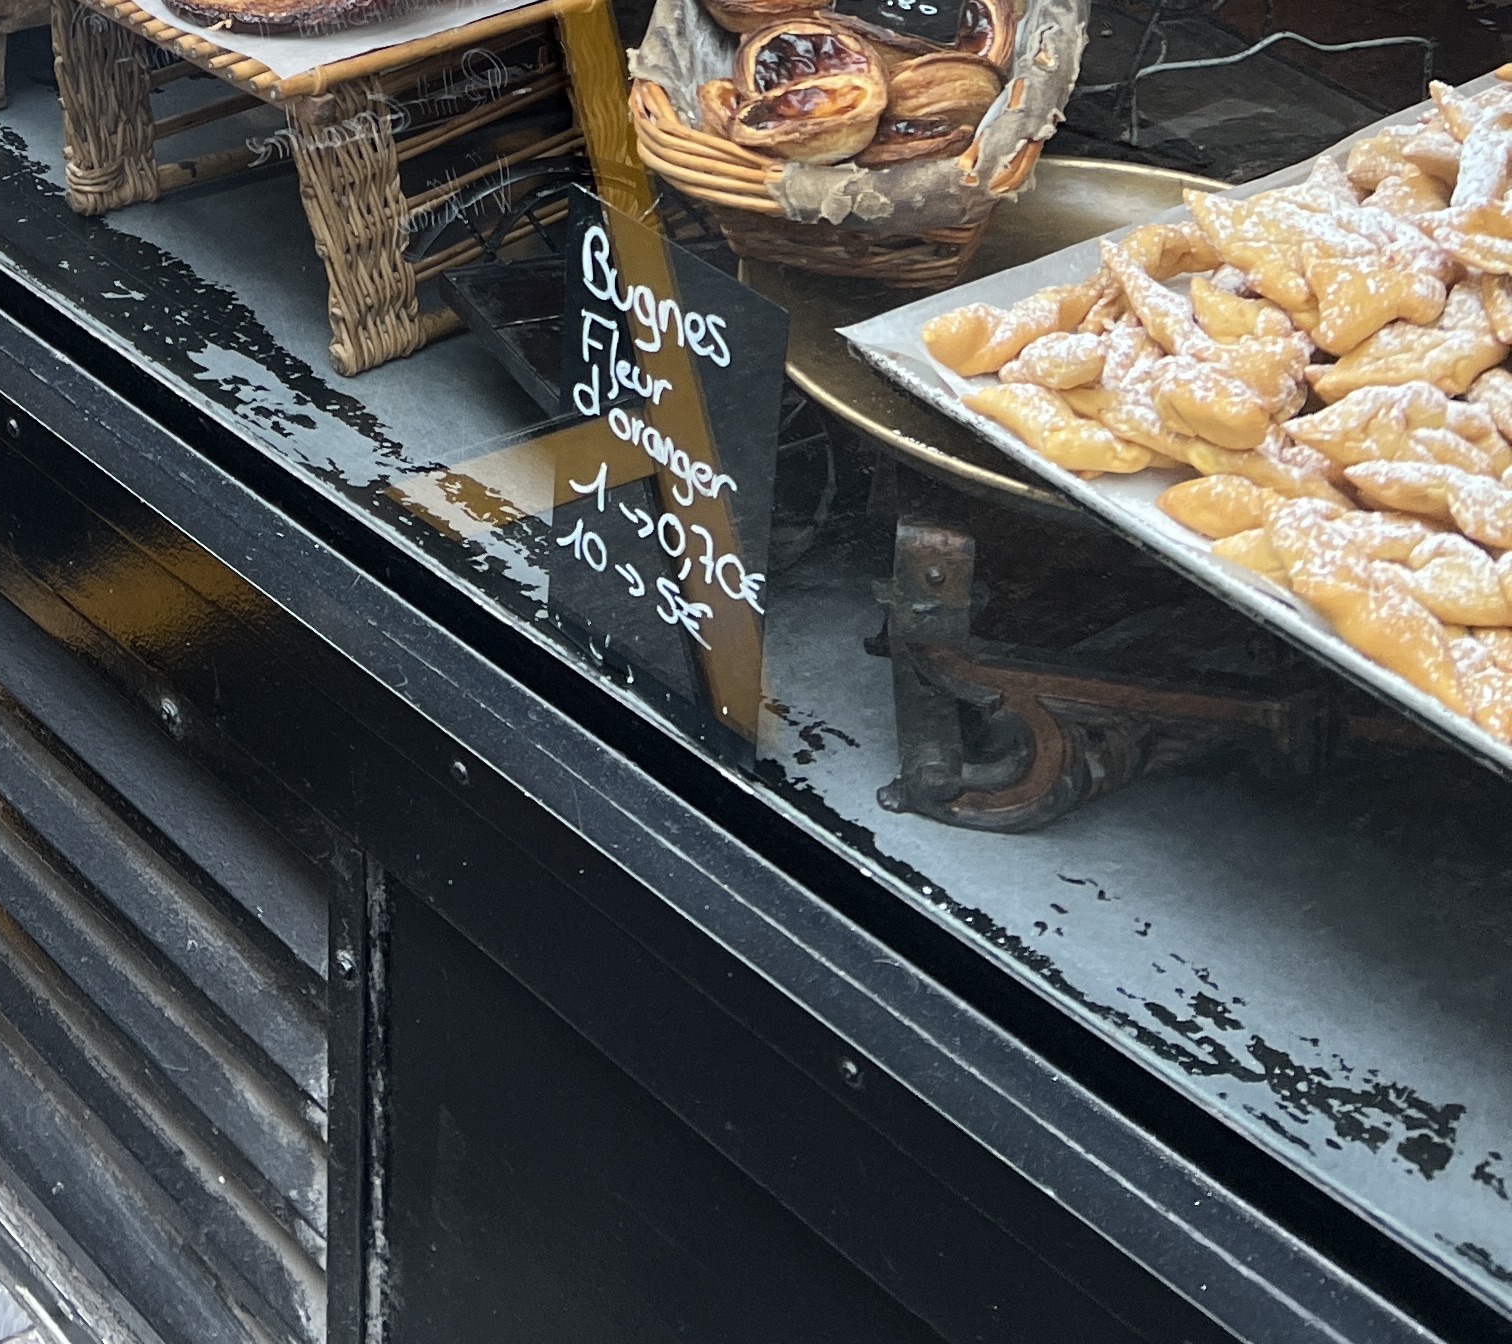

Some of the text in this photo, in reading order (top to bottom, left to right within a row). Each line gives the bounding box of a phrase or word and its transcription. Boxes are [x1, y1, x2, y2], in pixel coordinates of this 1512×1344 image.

[580, 225, 732, 368] Bugnes
[580, 307, 674, 406] Fleur
[556, 518, 608, 573] 10
